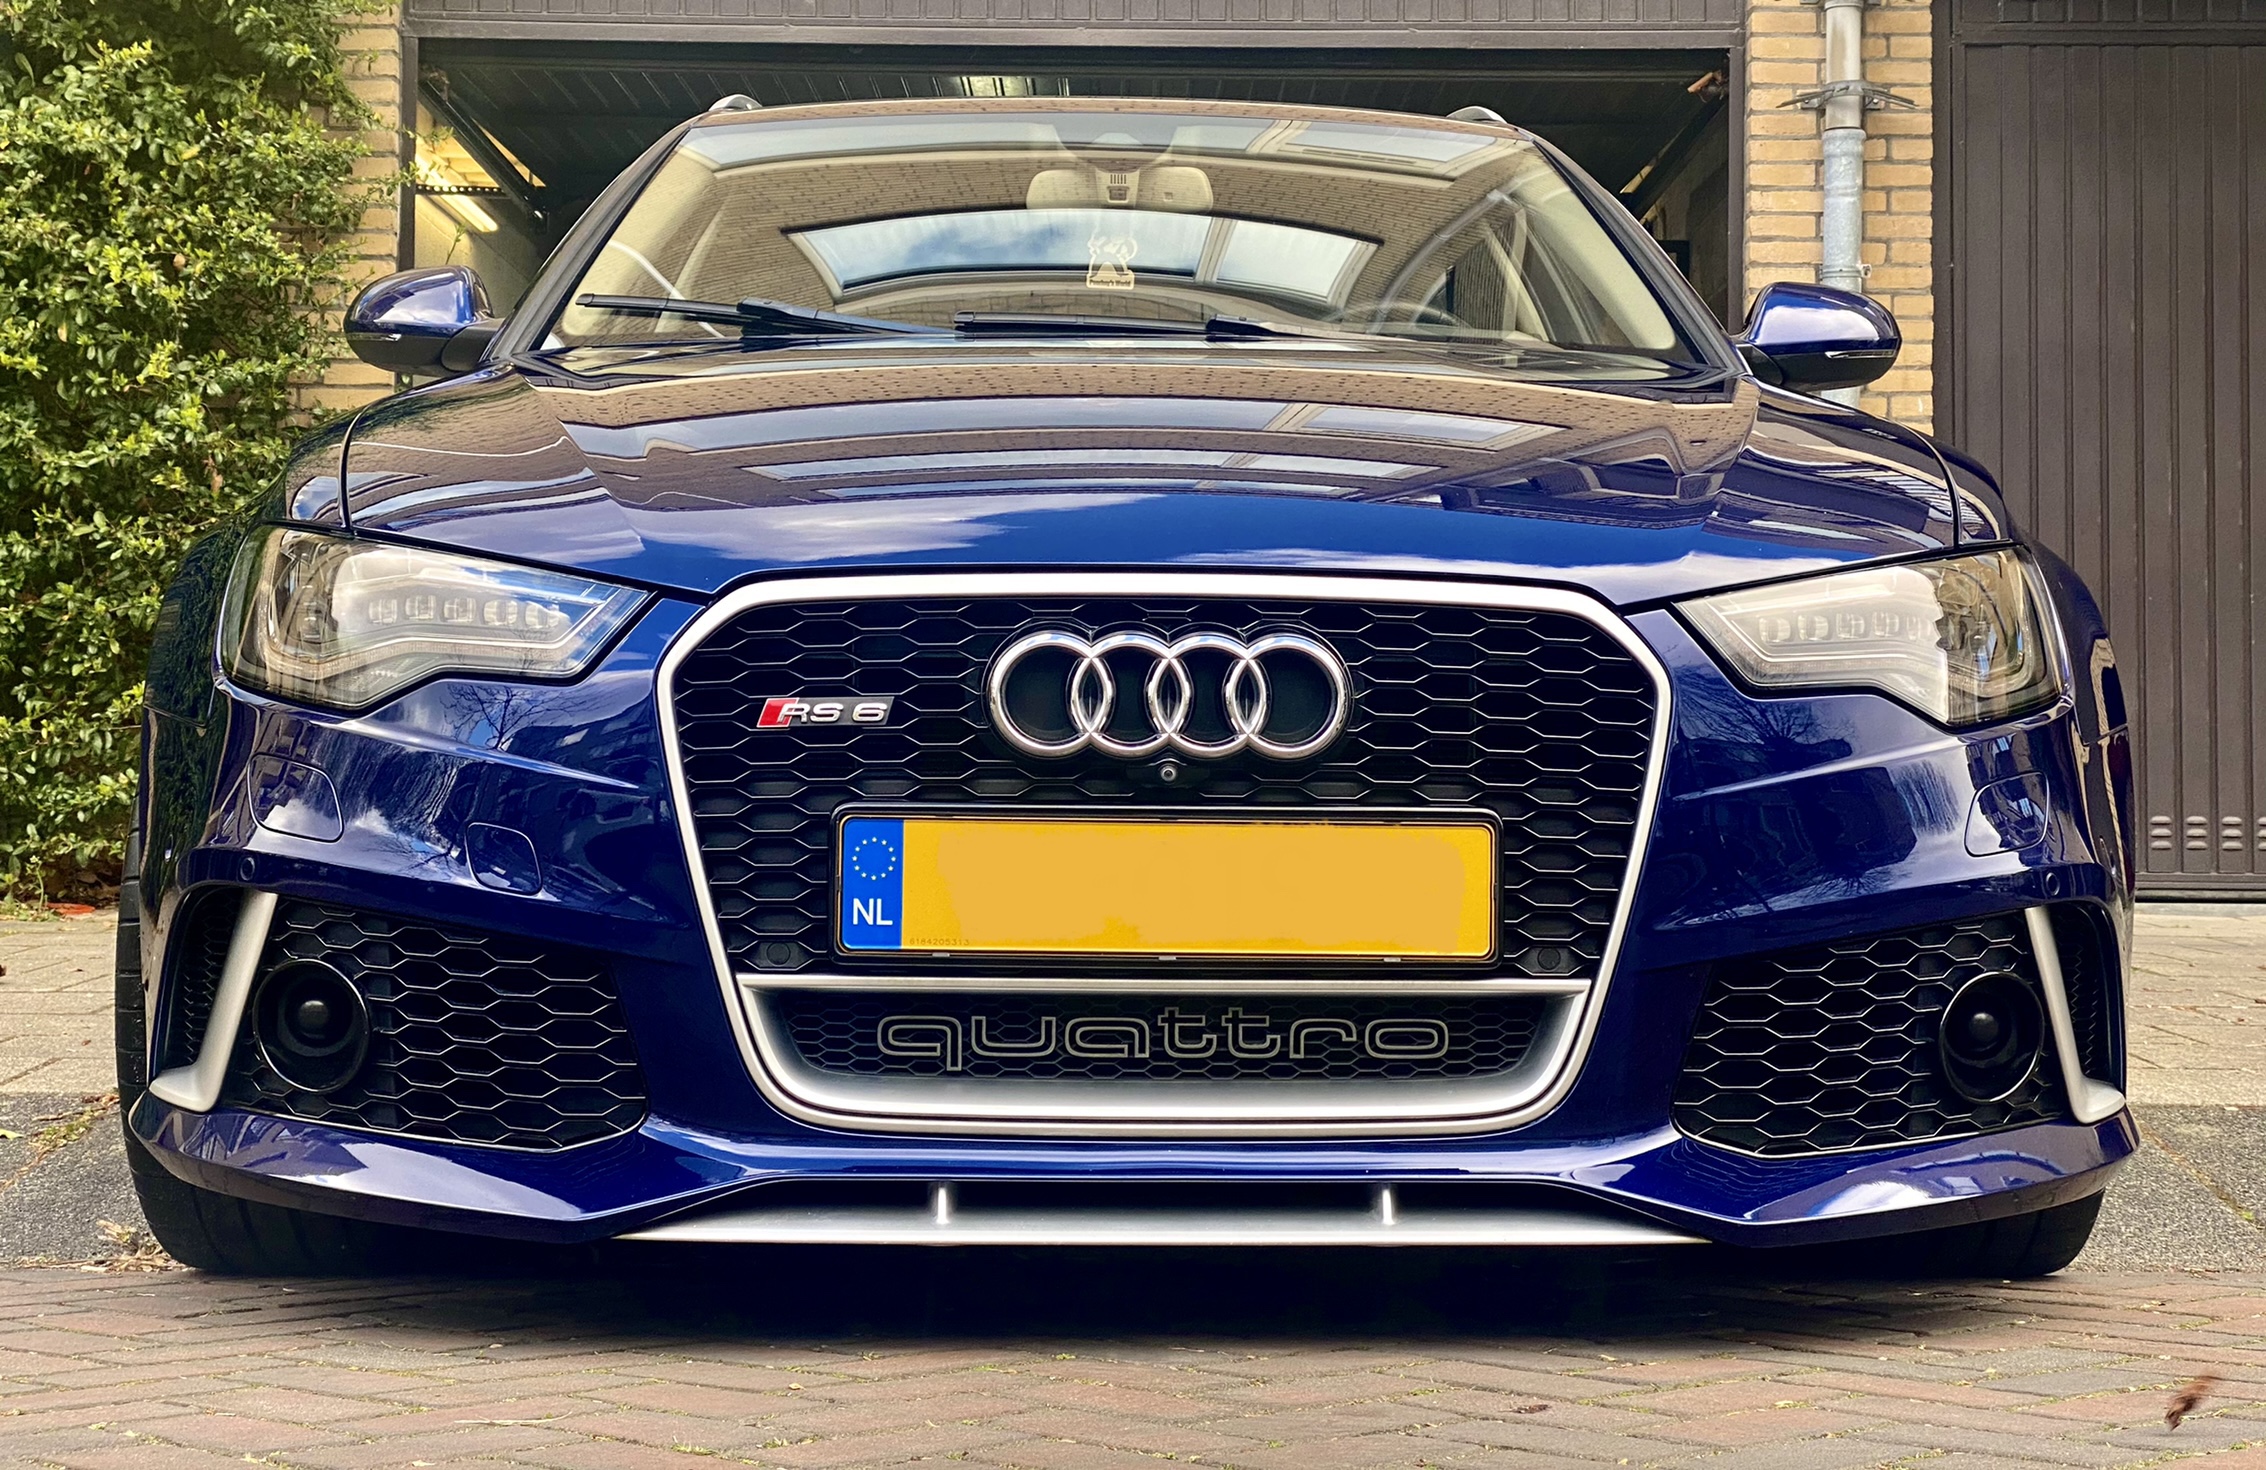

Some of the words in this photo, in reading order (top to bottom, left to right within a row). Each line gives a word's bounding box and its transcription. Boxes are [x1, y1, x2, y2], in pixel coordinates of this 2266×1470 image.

[776, 702, 844, 723] RS
[852, 702, 888, 723] 6
[852, 898, 893, 926] NL
[909, 937, 970, 946] 6184205313
[877, 1006, 1449, 1072] quattro
